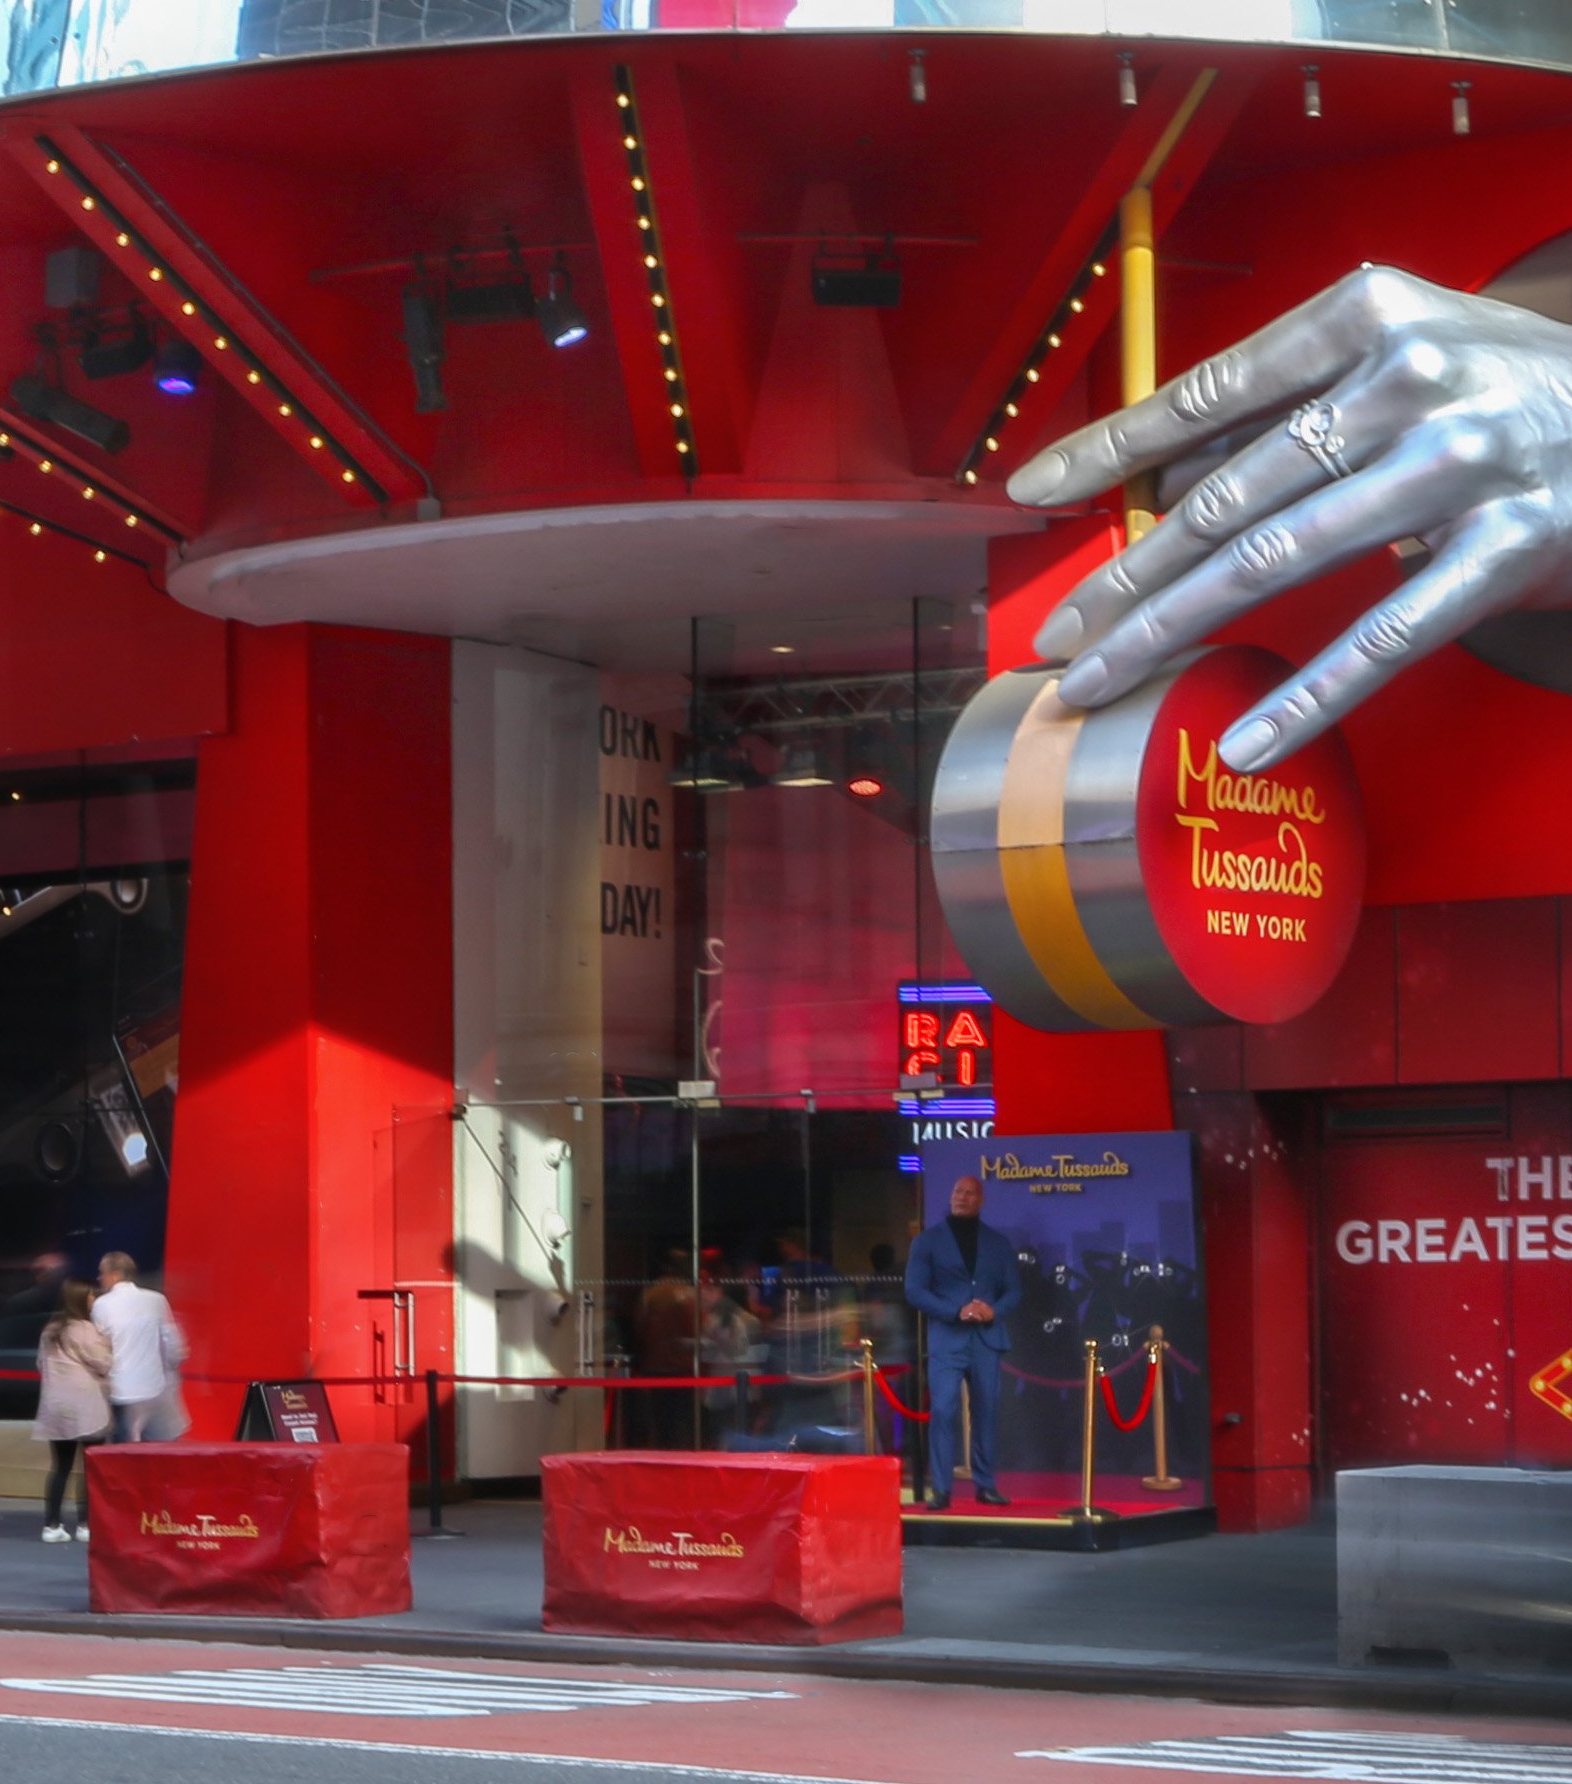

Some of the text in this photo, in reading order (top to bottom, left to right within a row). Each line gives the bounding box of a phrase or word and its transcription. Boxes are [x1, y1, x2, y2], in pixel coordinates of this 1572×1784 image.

[1174, 813, 1323, 899] Tussauds
[1206, 909, 1307, 943] NEW YORK
[980, 1151, 1130, 1181] Madame Tussauds
[1029, 1182, 1083, 1194] NEW YORK
[602, 1525, 746, 1559] Madame Tussauds
